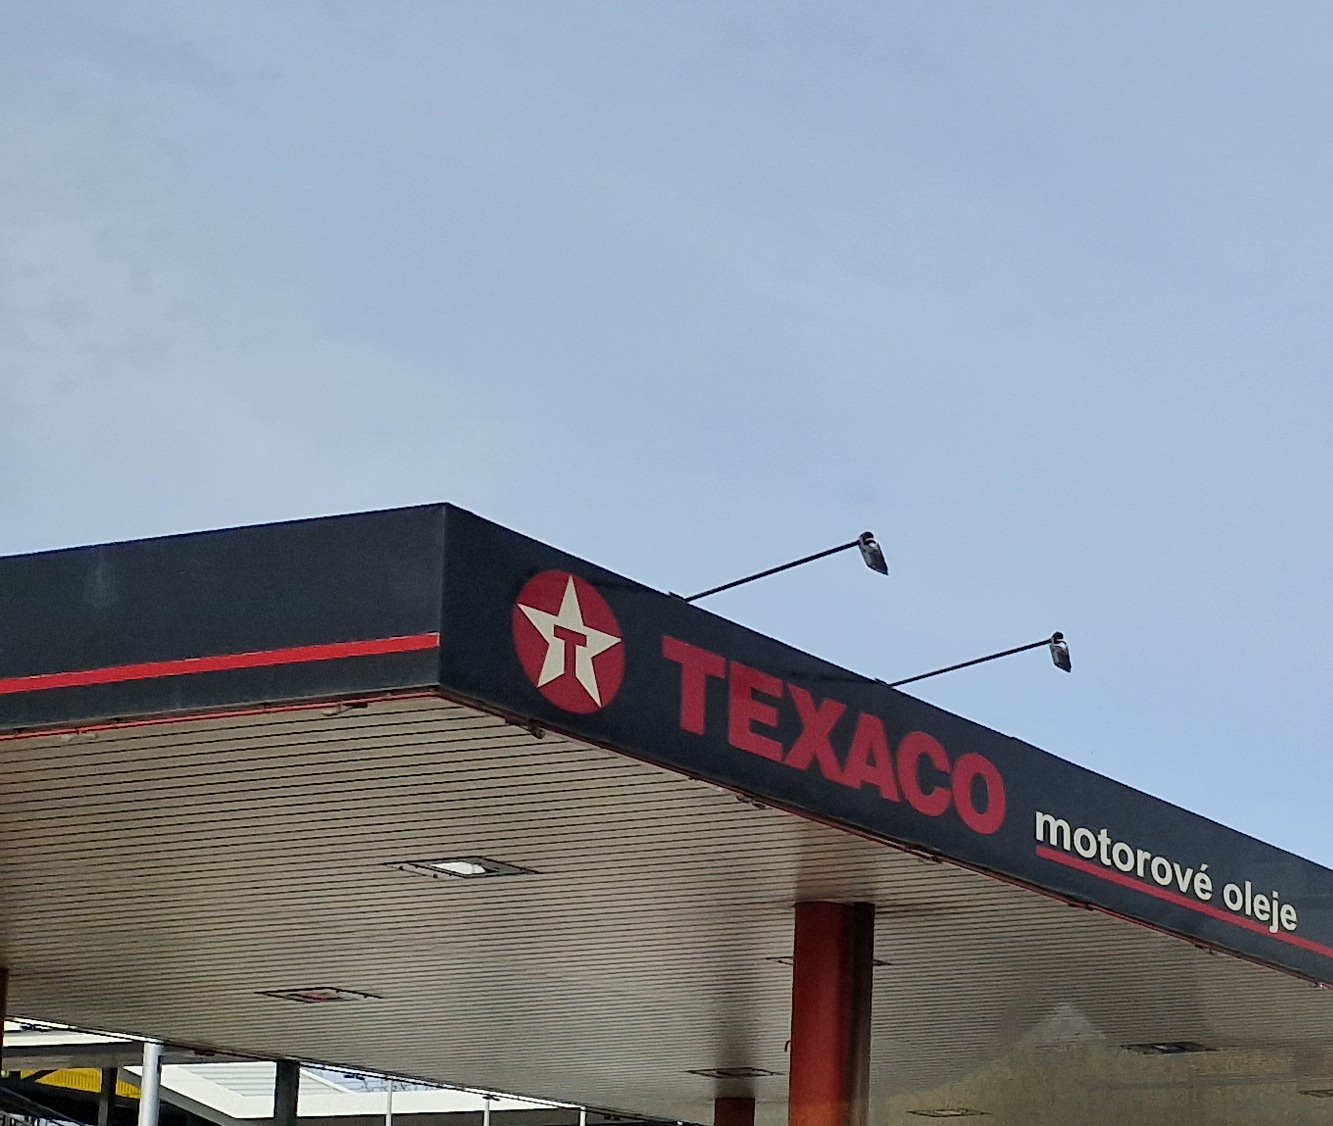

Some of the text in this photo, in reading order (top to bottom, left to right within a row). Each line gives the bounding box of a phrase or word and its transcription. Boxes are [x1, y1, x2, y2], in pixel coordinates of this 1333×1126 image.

[660, 634, 1008, 835] TEXACO
[1035, 810, 1298, 934] motorové oleje
